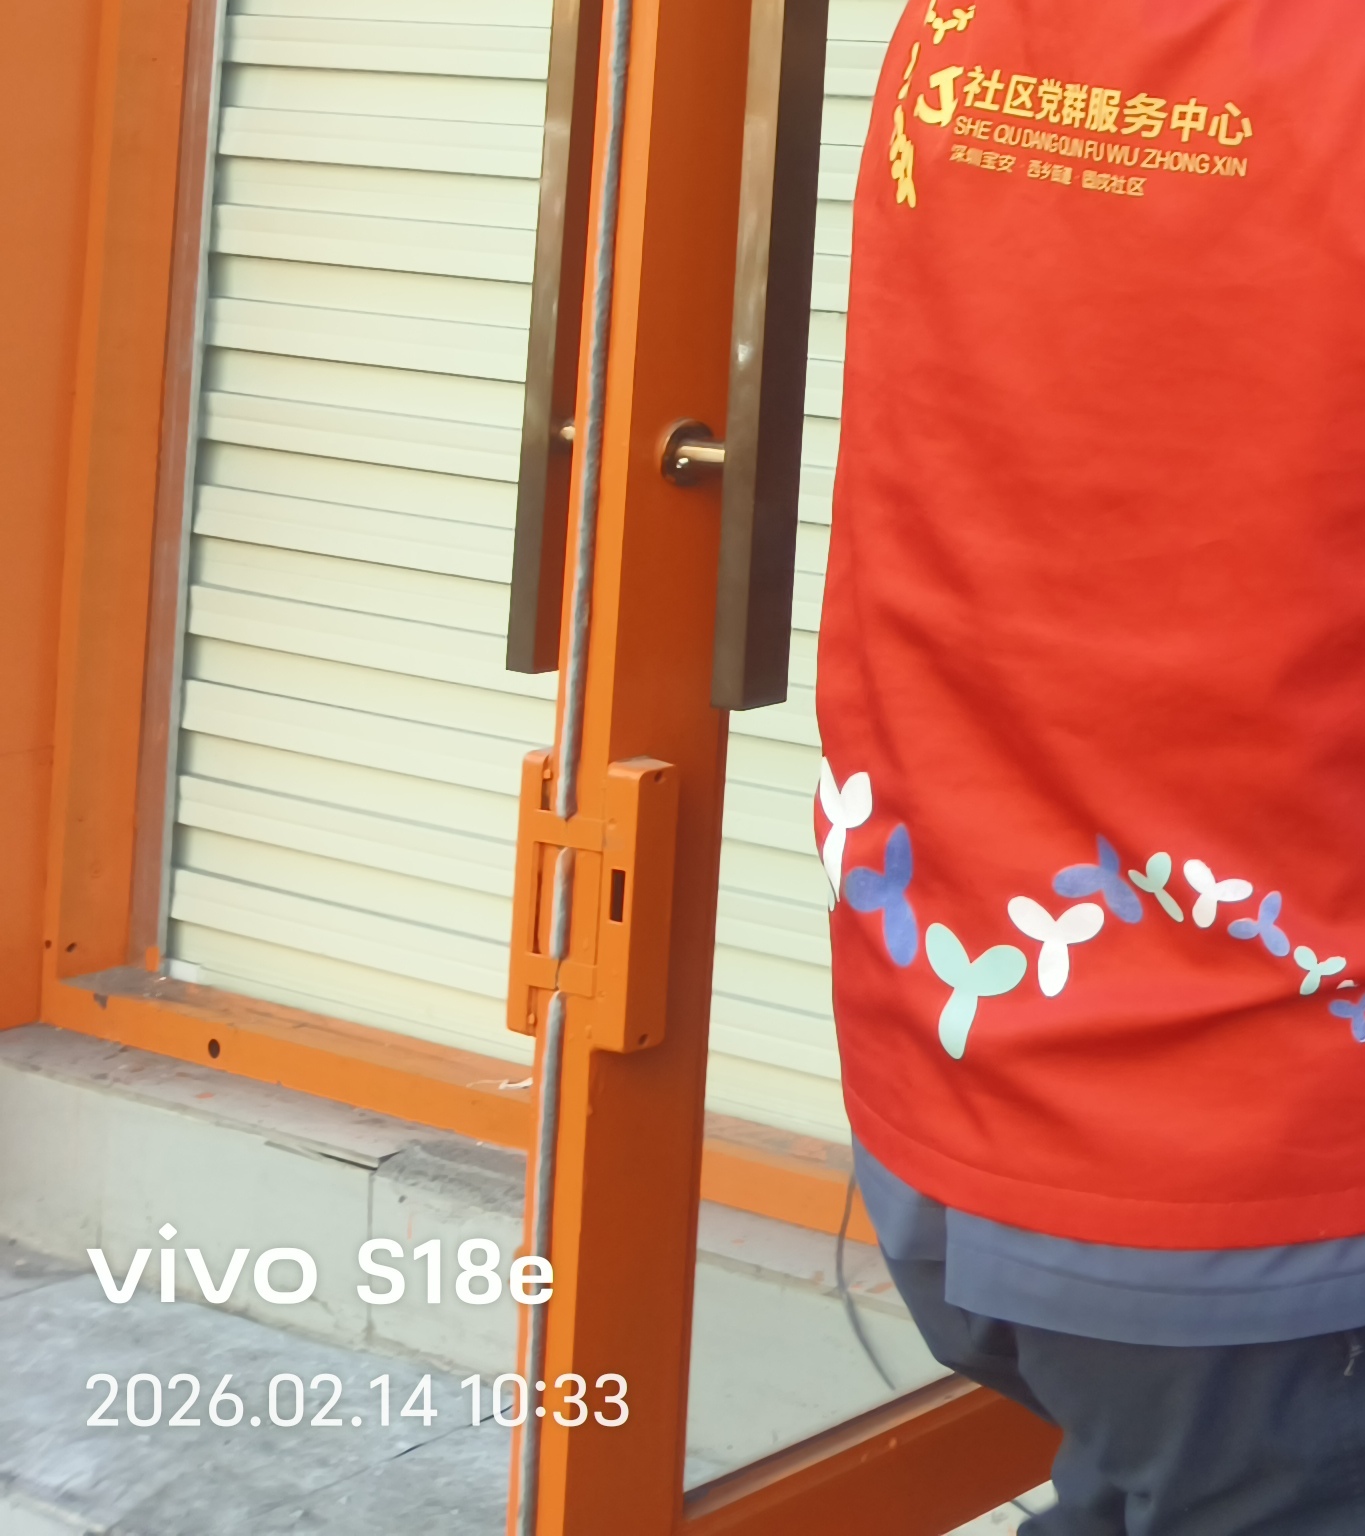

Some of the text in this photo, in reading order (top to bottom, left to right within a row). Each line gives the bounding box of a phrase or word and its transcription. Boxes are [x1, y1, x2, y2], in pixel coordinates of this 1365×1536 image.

[963, 65, 1253, 147] 社区党群服务中心
[953, 115, 993, 141] SHE
[1105, 143, 1140, 167] WU
[1140, 148, 1211, 175] ZHONG
[1211, 155, 1248, 178] XIN
